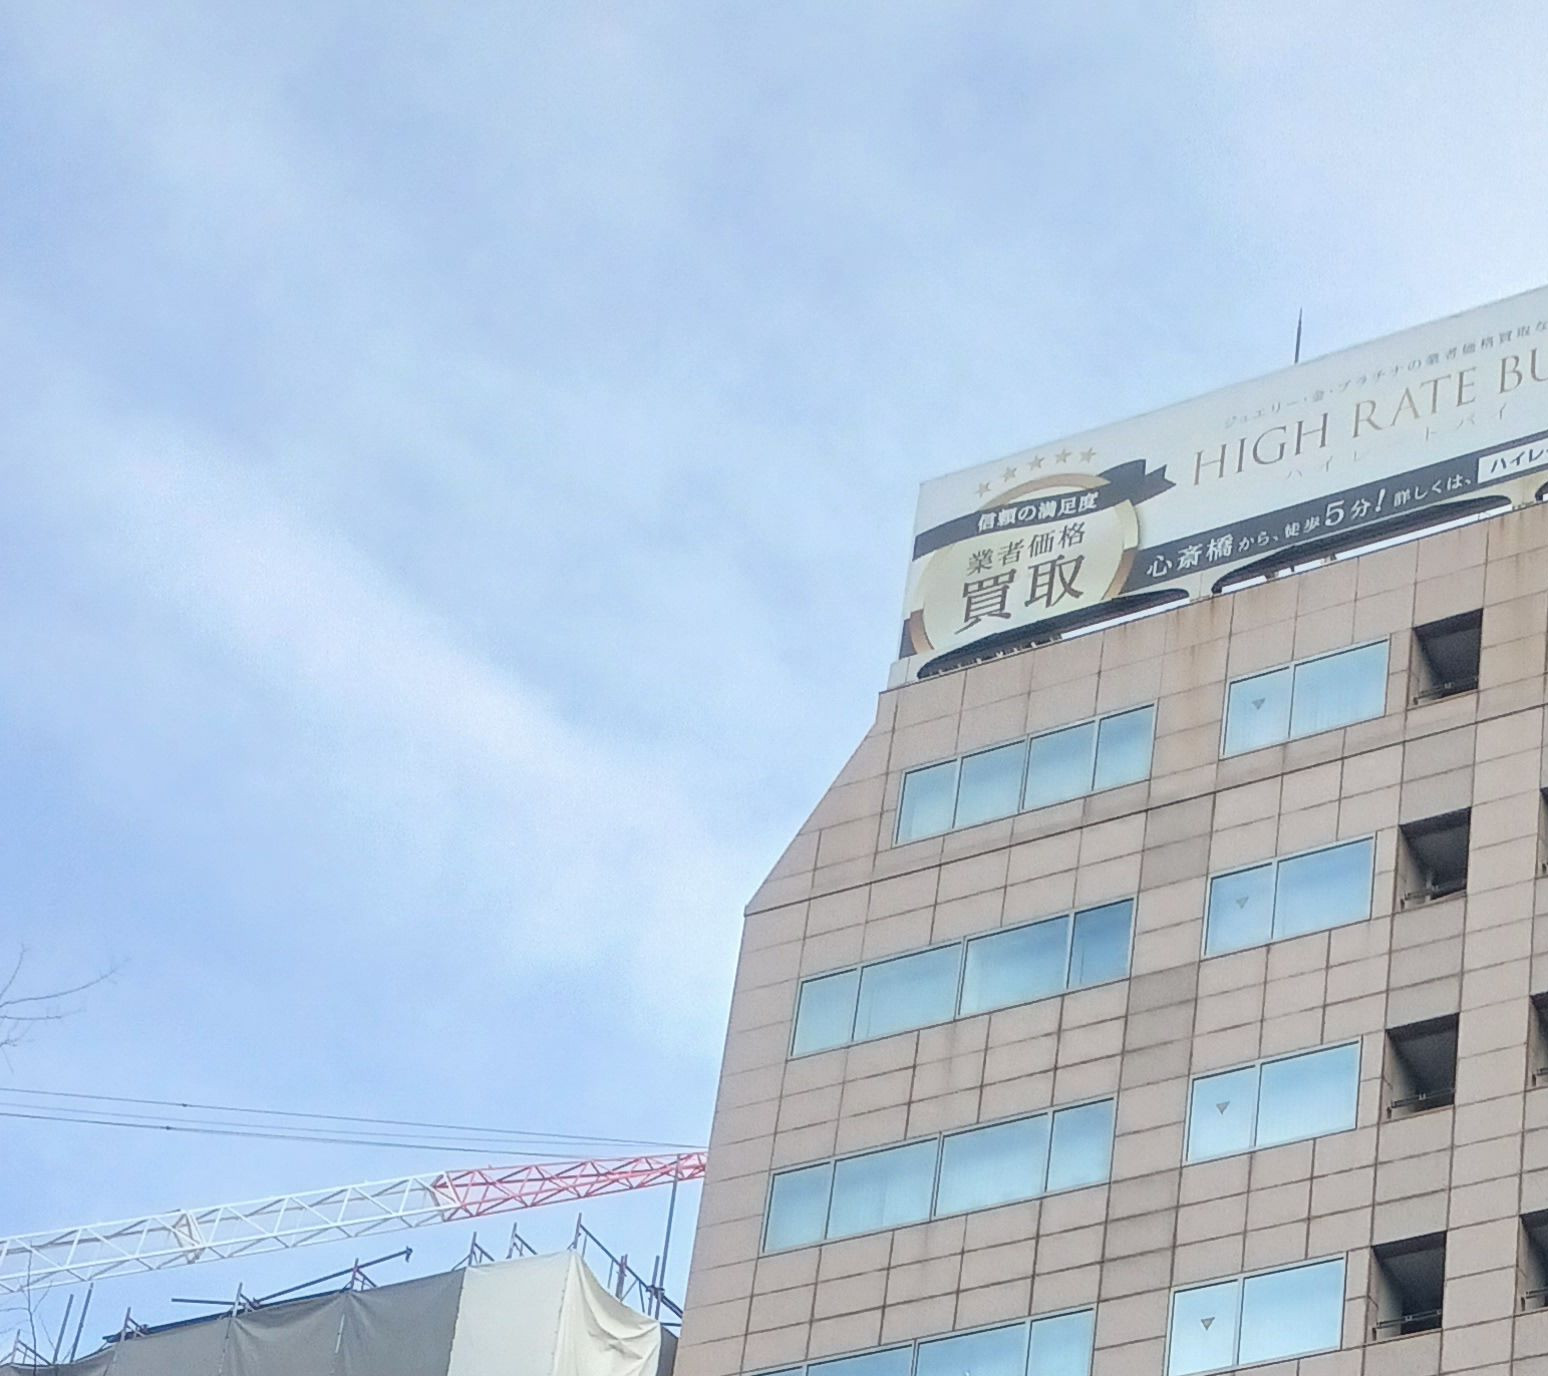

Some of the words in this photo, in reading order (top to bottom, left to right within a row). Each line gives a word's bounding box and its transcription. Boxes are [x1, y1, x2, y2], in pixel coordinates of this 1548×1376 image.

[1193, 411, 1331, 486] HIGH
[1351, 366, 1478, 439] RATE
[977, 490, 1100, 534] 信頼の満足度
[967, 521, 1087, 576] 業者価格
[954, 553, 1087, 635] 買取
